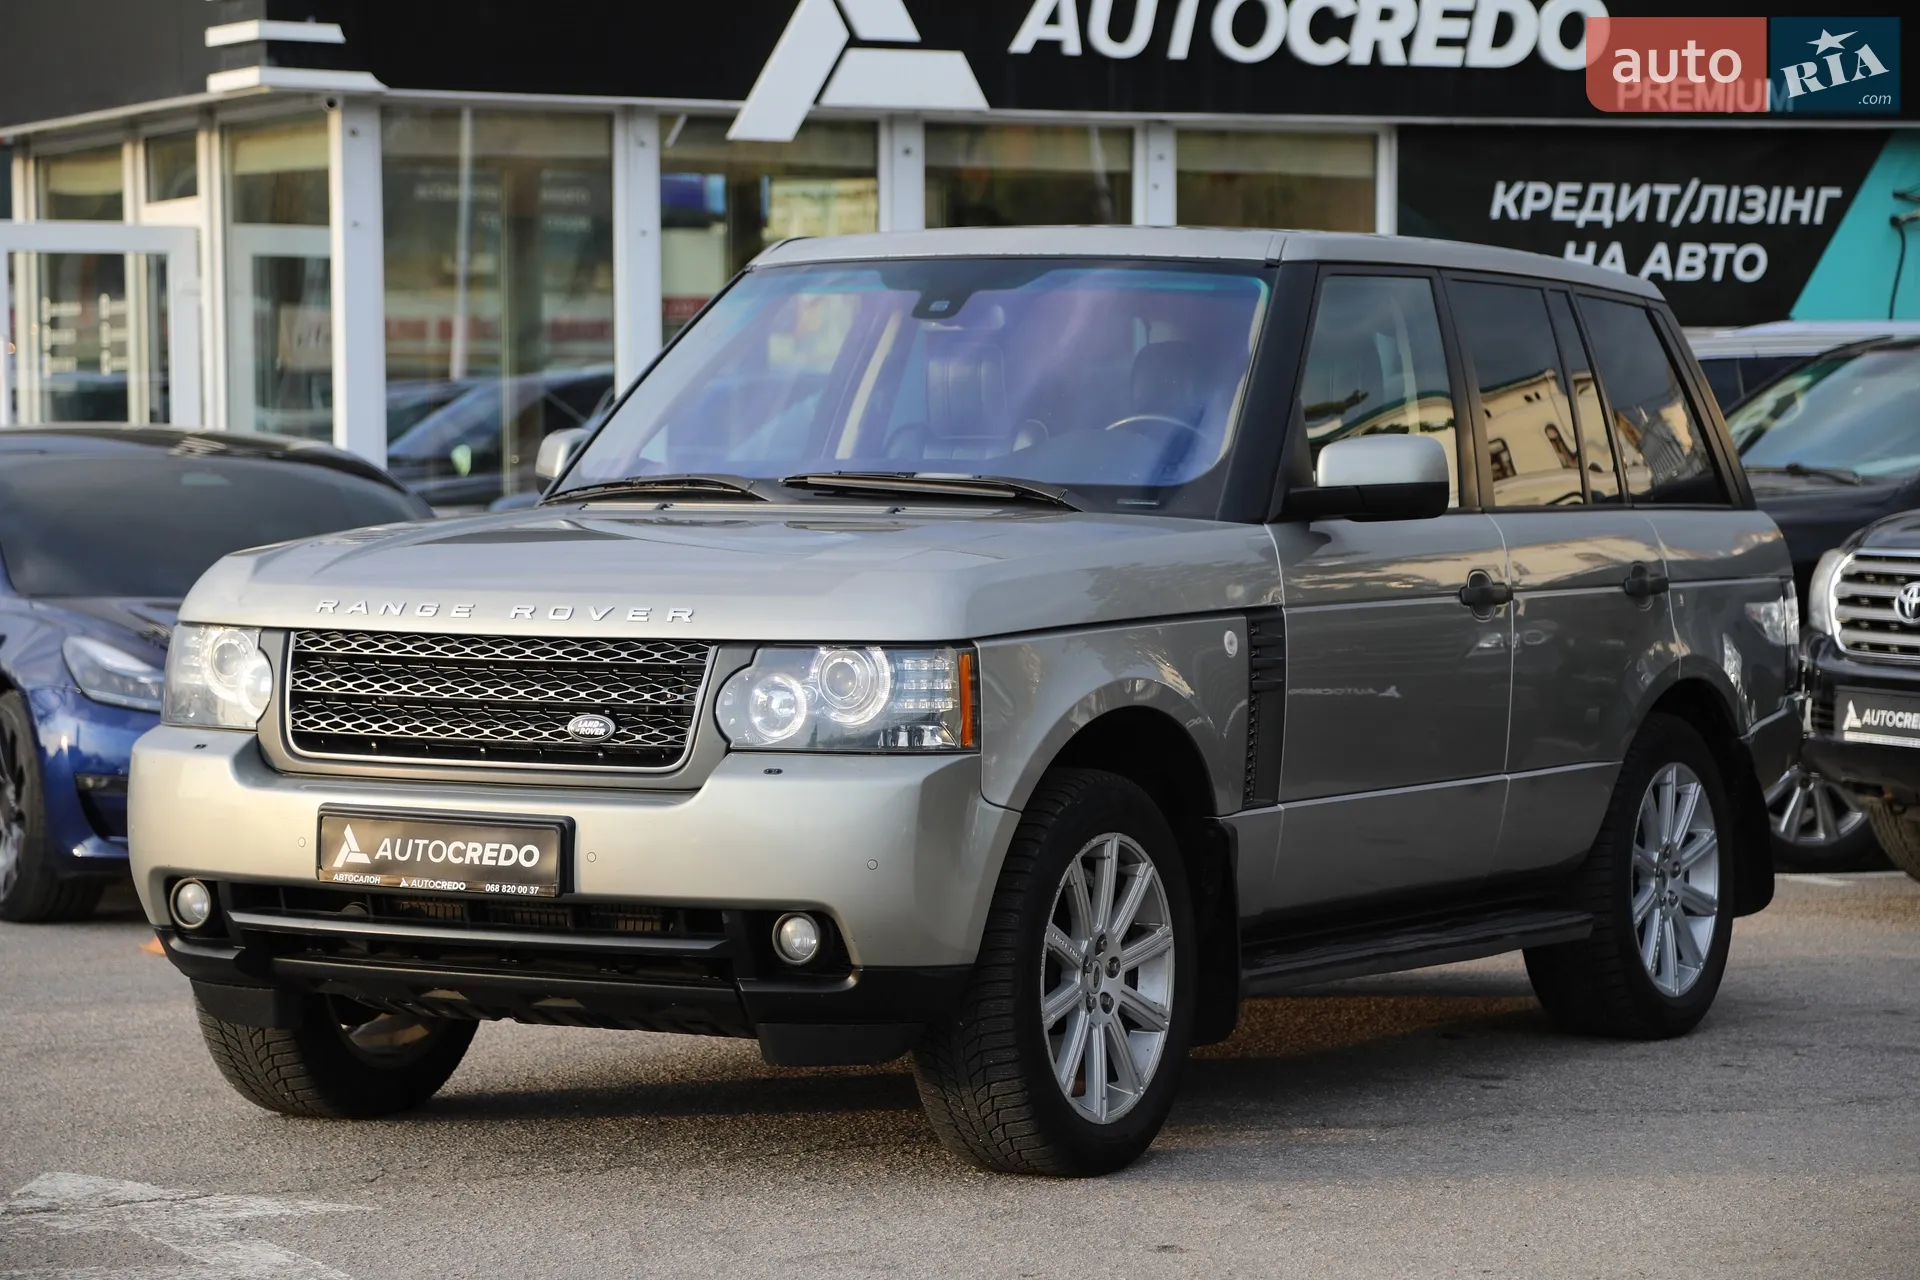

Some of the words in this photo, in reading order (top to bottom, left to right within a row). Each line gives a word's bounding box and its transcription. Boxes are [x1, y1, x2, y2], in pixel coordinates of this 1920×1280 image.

[1489, 177, 1843, 229] КРЕДИТ/ЛІЗІНГ
[1638, 241, 1769, 283] АВТО
[315, 599, 476, 620] RANGE
[508, 604, 695, 624] ROVER
[578, 720, 600, 728] LAND
[1862, 708, 1920, 730] AUTOCRE
[579, 727, 606, 736] ROVER
[374, 837, 540, 868] AUTOCREDO
[333, 873, 381, 885] АВТОСАЛОН
[411, 879, 467, 891] AUTOCREDO
[485, 883, 500, 893] 068
[501, 884, 516, 894] 820
[518, 885, 528, 894] 00
[529, 886, 540, 895] 37
